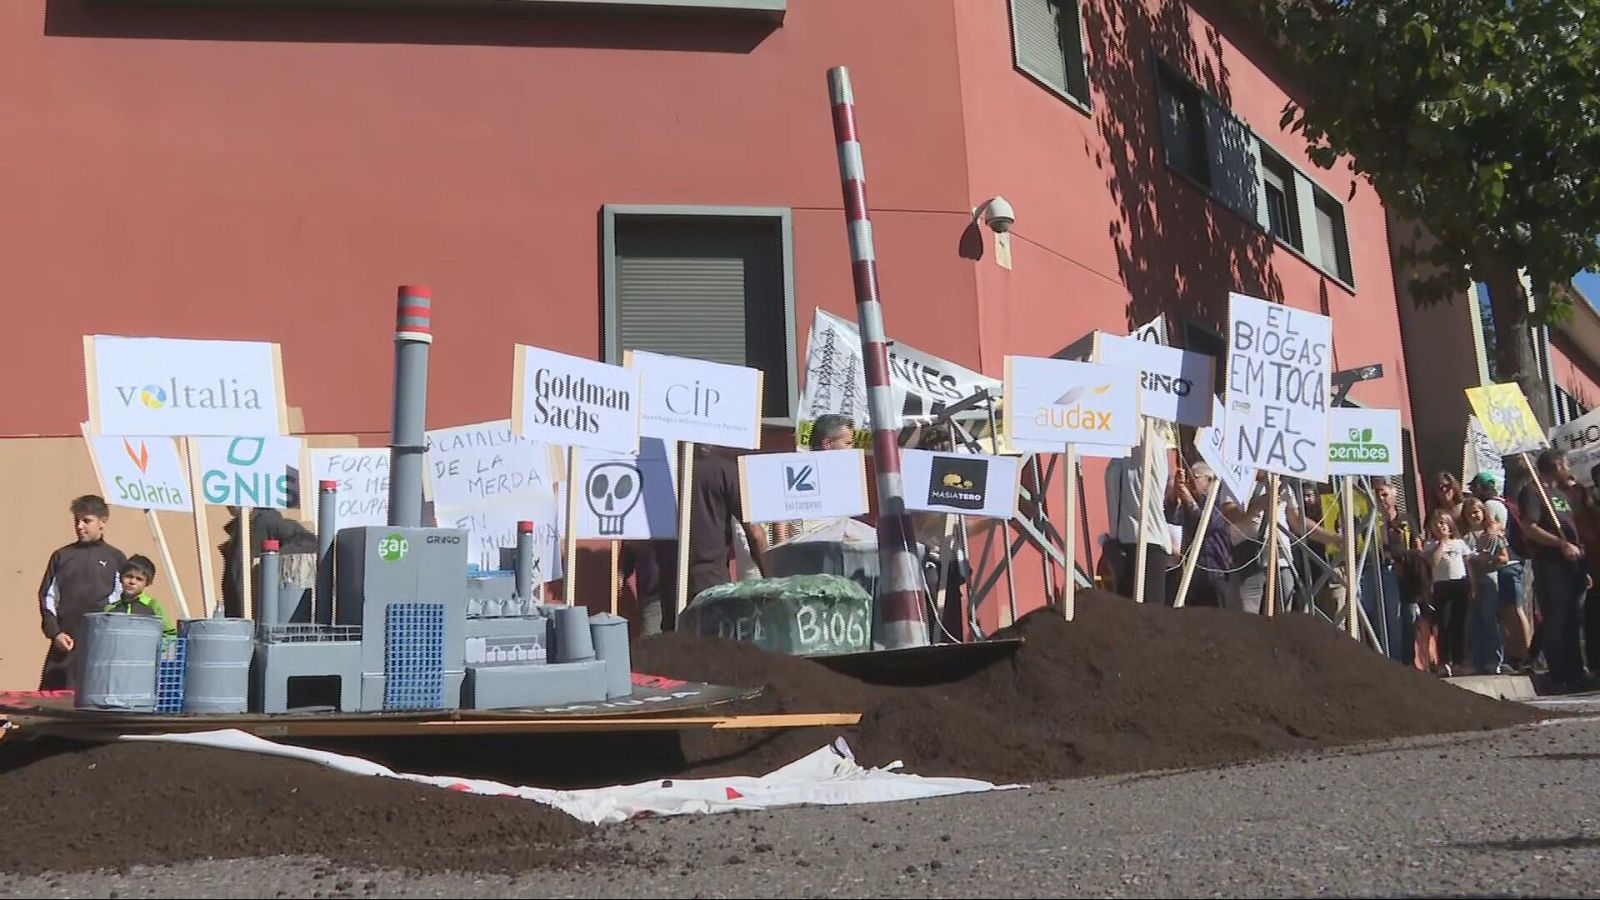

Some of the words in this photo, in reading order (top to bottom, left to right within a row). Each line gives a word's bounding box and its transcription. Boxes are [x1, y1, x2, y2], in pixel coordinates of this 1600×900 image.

[1267, 306, 1299, 335] EL
[1234, 320, 1326, 366] BIOGAS
[116, 376, 262, 410] voltalia
[534, 368, 630, 411] Goldman
[1230, 353, 1265, 398] EM
[1269, 361, 1325, 413] TOCA
[534, 394, 600, 433] Sachs
[1035, 402, 1112, 431] audax
[1264, 405, 1301, 434] EL
[328, 454, 389, 473] FORA
[1237, 425, 1316, 472] NAS
[435, 459, 459, 479] DE
[476, 454, 502, 474] LA
[115, 475, 183, 505] Solaria
[202, 469, 296, 508] GNIS
[468, 467, 542, 497] MERDA
[378, 538, 408, 560] gap
